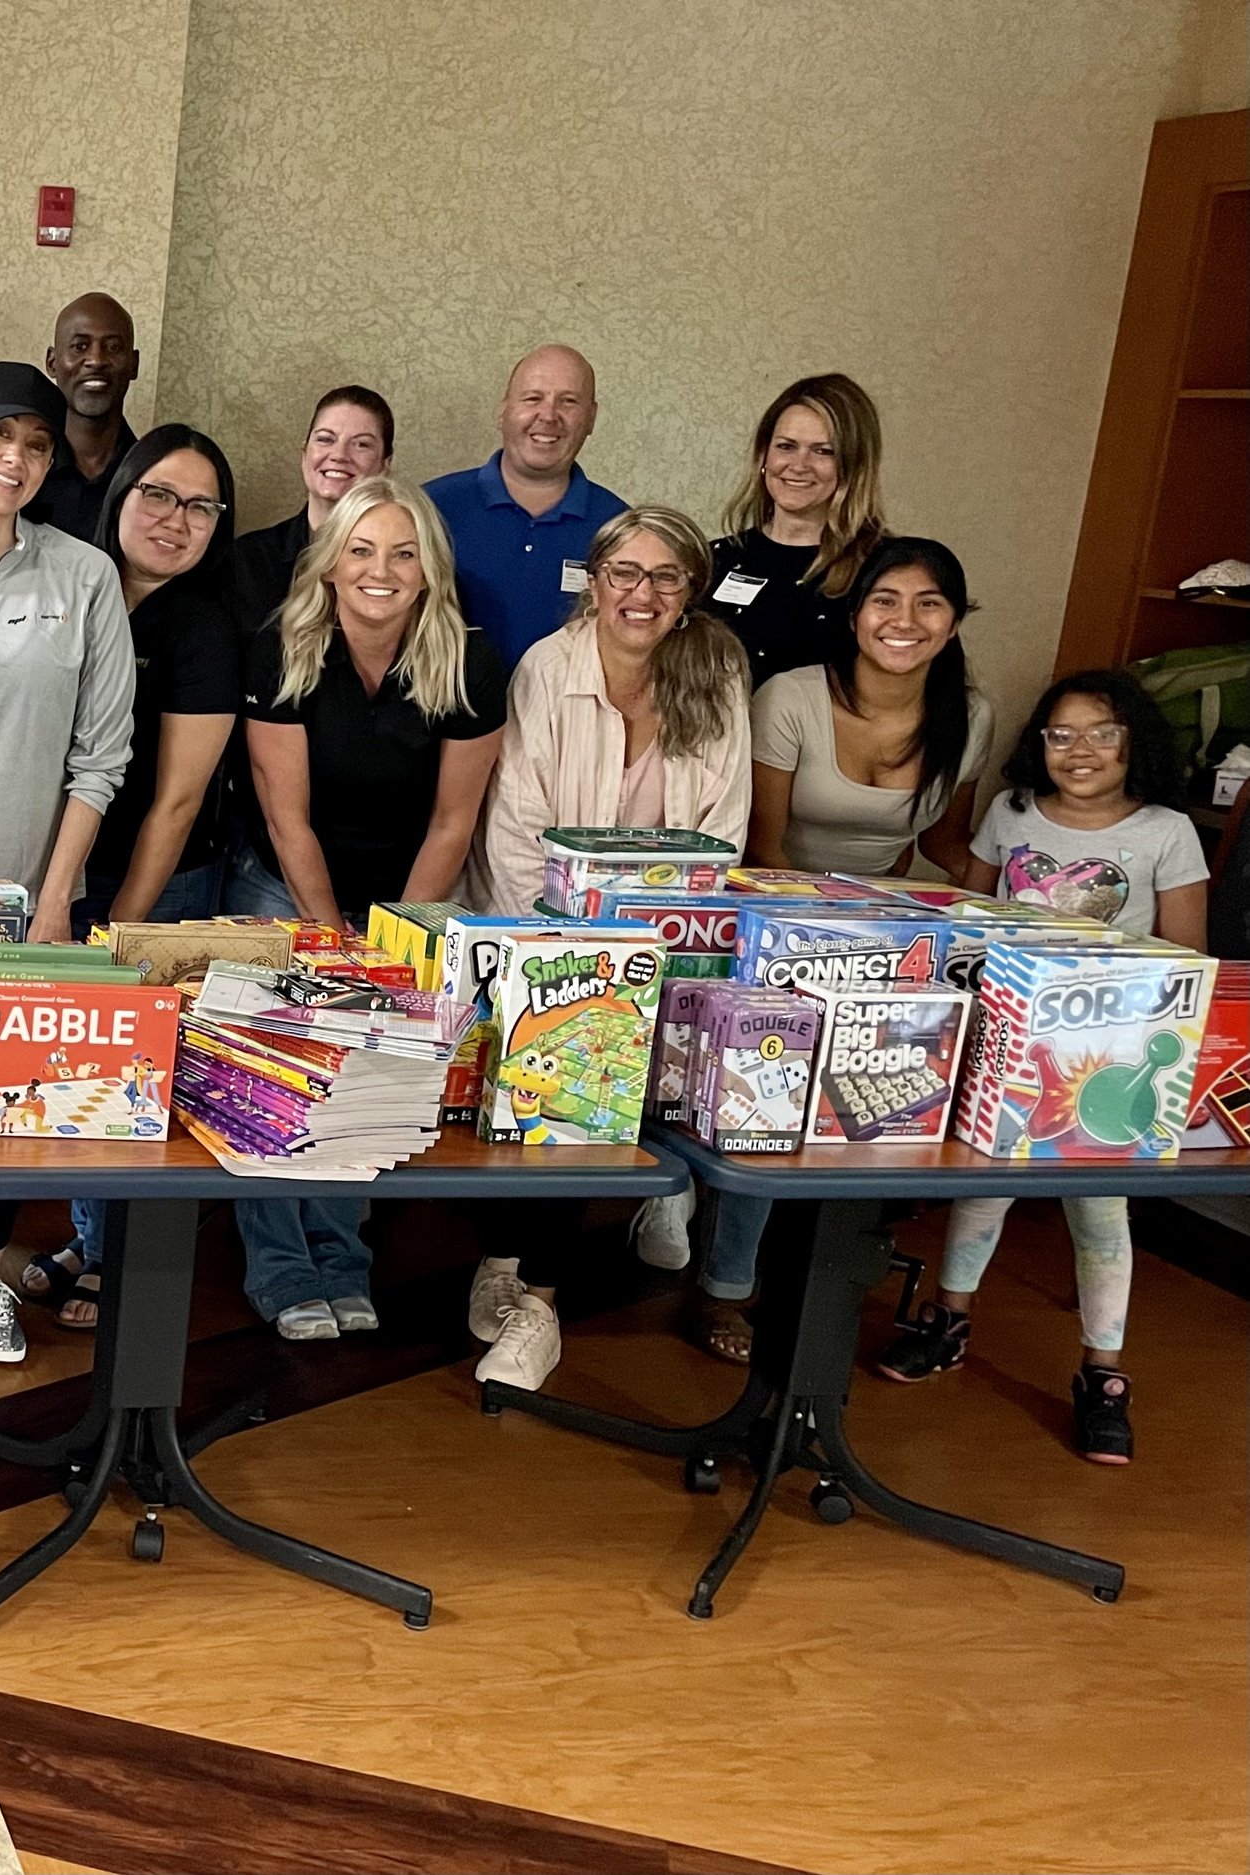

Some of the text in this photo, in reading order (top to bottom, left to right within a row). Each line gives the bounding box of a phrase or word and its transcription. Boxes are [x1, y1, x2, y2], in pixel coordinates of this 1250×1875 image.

[816, 938, 849, 950] classic
[851, 937, 881, 949] game
[524, 951, 599, 988] Snakes
[597, 952, 616, 979] &
[768, 936, 935, 987] CONNECT 4
[306, 991, 329, 1006] UNO
[531, 976, 607, 1015] Ladders
[1035, 975, 1196, 1031] SORRY!
[739, 1015, 813, 1037] DOUBLE
[834, 1000, 916, 1027] Super
[766, 1040, 777, 1055] 6
[832, 1023, 878, 1051] Big
[973, 1008, 989, 1072] SORRY!
[994, 1018, 1010, 1082] SORRY!
[829, 1043, 928, 1076] Boggle
[724, 1139, 793, 1151] DOMINOES
